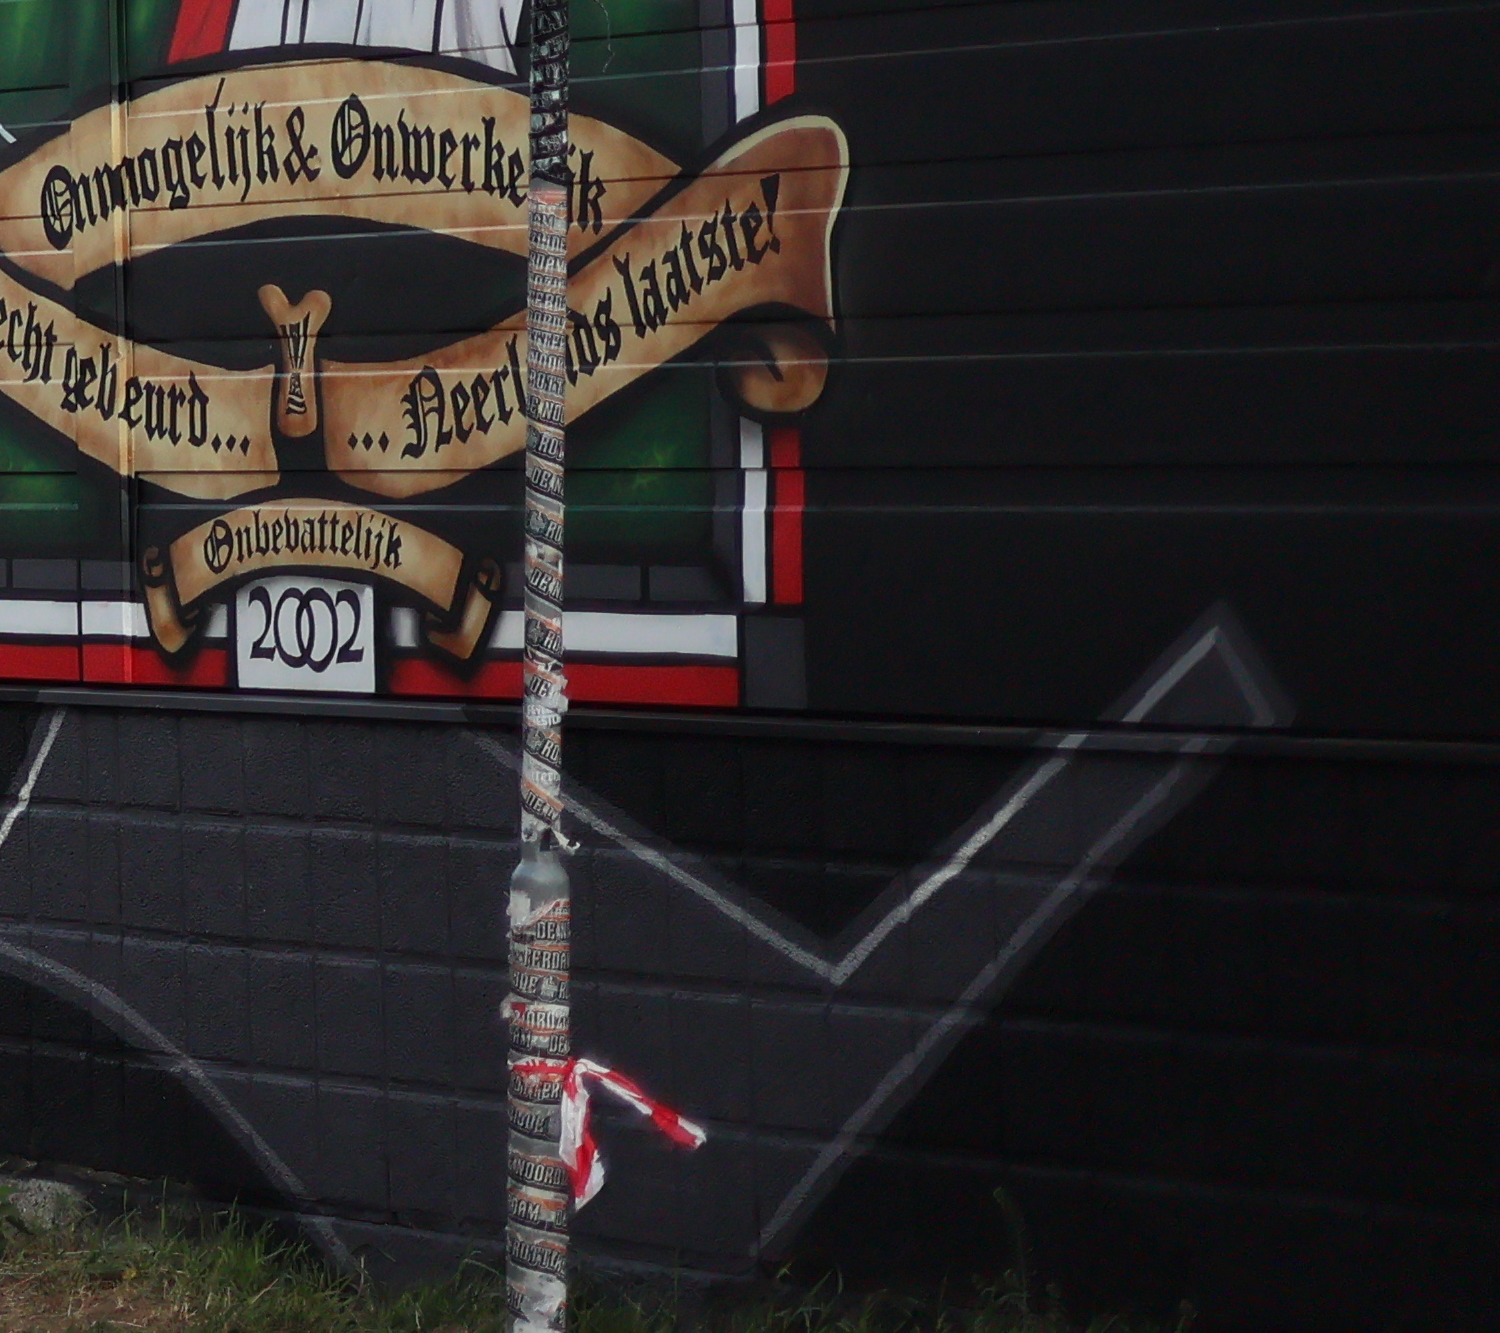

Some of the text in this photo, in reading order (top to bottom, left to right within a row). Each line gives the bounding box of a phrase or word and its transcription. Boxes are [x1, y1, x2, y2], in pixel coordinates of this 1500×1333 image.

[40, 77, 278, 249] Onmogelijk
[612, 172, 781, 338] laatste!
[203, 507, 403, 574] Onbevattelijk
[248, 583, 366, 673] 2002
